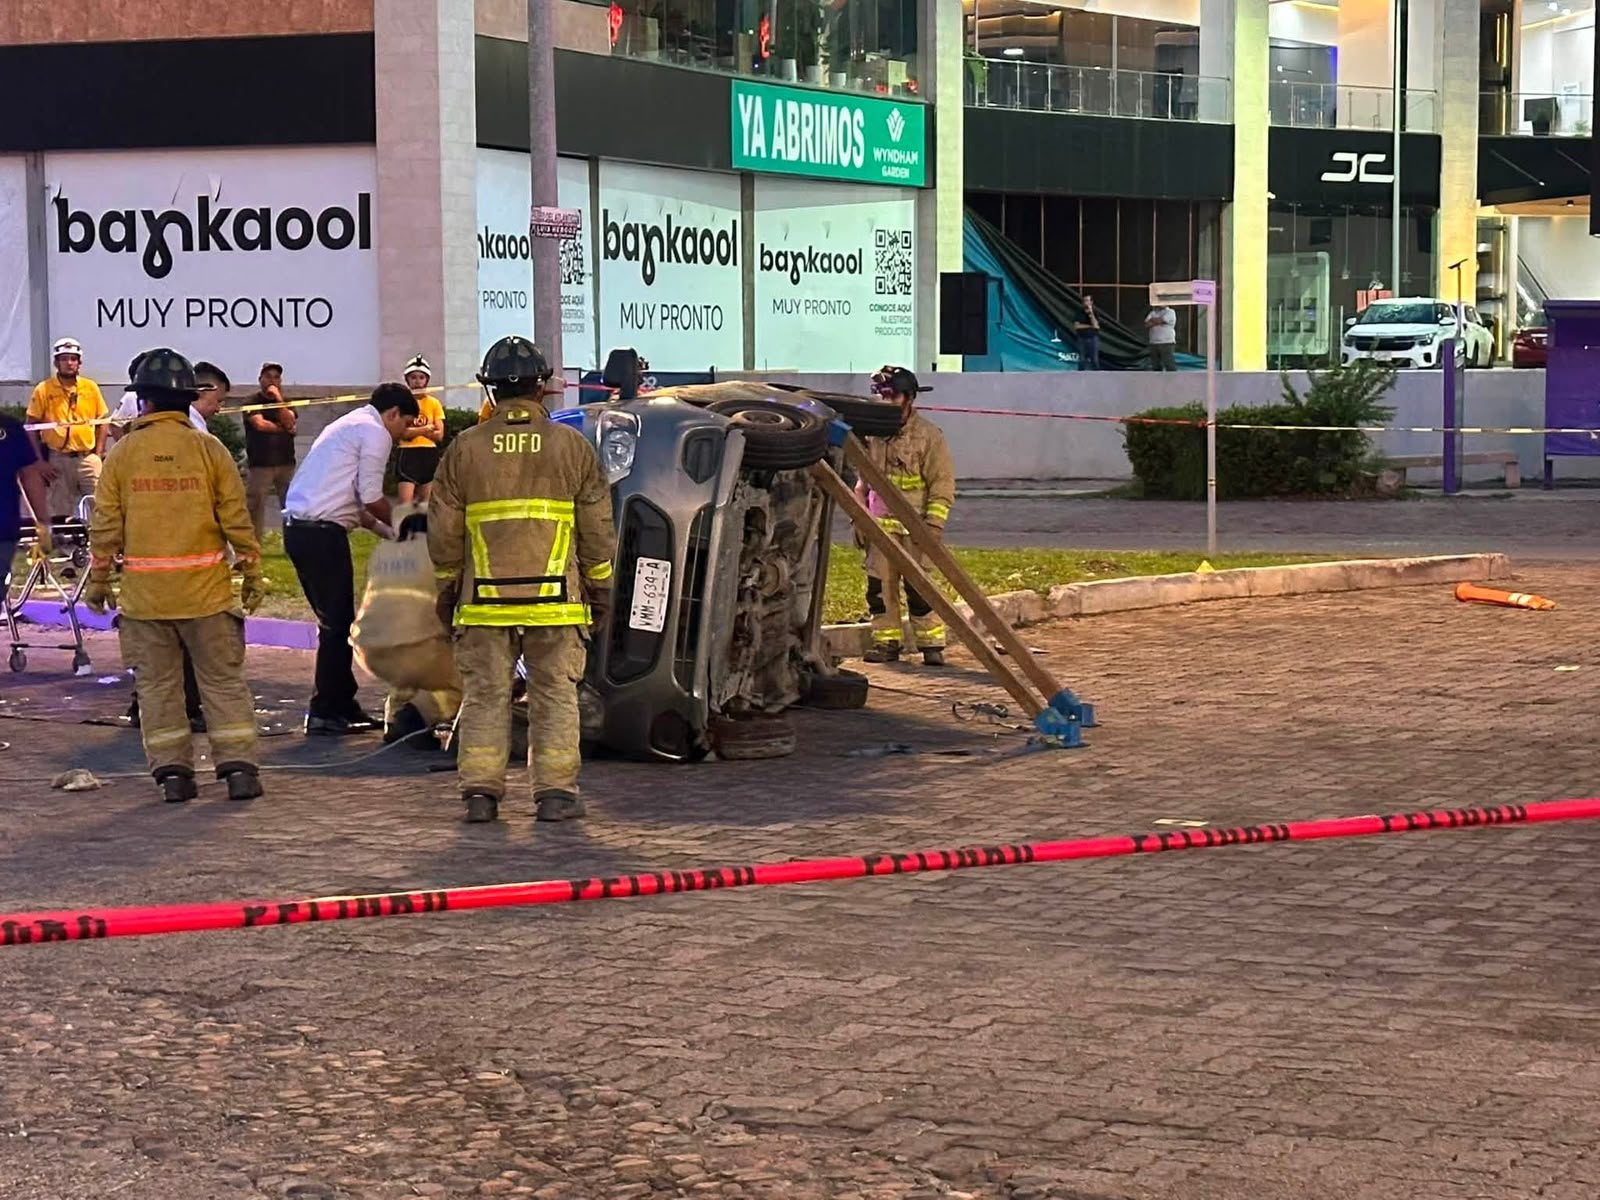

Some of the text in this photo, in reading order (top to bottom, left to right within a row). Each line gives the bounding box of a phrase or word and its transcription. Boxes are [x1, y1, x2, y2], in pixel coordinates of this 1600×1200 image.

[738, 93, 865, 168] YA ABRIMOS
[873, 147, 919, 165] WYNDHAM
[881, 165, 910, 179] GARDEN
[55, 192, 371, 279] bankaool
[602, 209, 737, 286] bankaool
[760, 243, 862, 285] bankaool
[482, 290, 527, 309] PRONTO
[772, 299, 851, 315] MUY PRONTO
[869, 303, 896, 312] CONOCE
[97, 297, 333, 328] MUY PRONTO
[620, 303, 723, 331] MUY PRONTO
[881, 315, 912, 324] NUESTROS
[875, 327, 912, 336] PRODUCTOS
